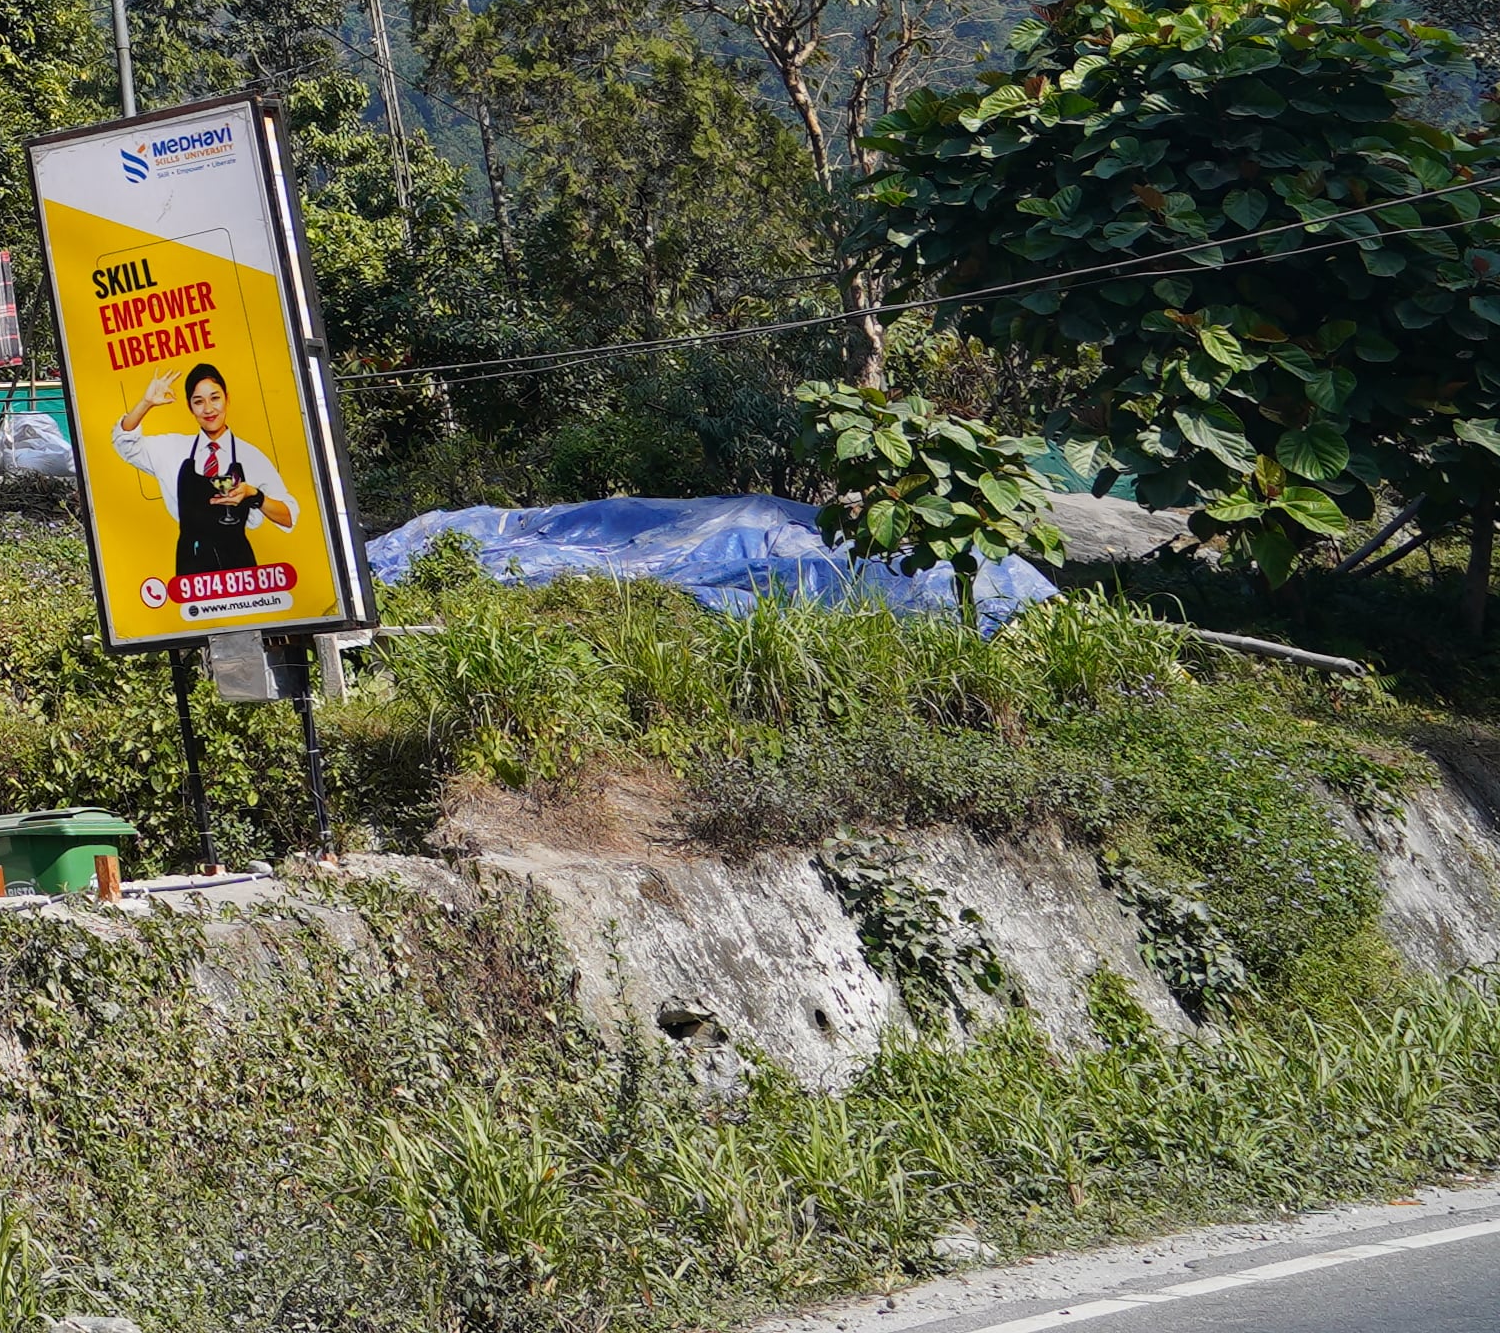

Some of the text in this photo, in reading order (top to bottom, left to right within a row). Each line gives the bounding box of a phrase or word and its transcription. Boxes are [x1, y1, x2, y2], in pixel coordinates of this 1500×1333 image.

[155, 144, 234, 166] SKILLS UNIVERSITY
[92, 258, 158, 299] SKILL
[99, 281, 217, 335] EMPOWER
[107, 318, 216, 371] LIBERATE
[180, 565, 287, 599] 9 874 875 876
[201, 595, 281, 614] www.msu.edu.in
